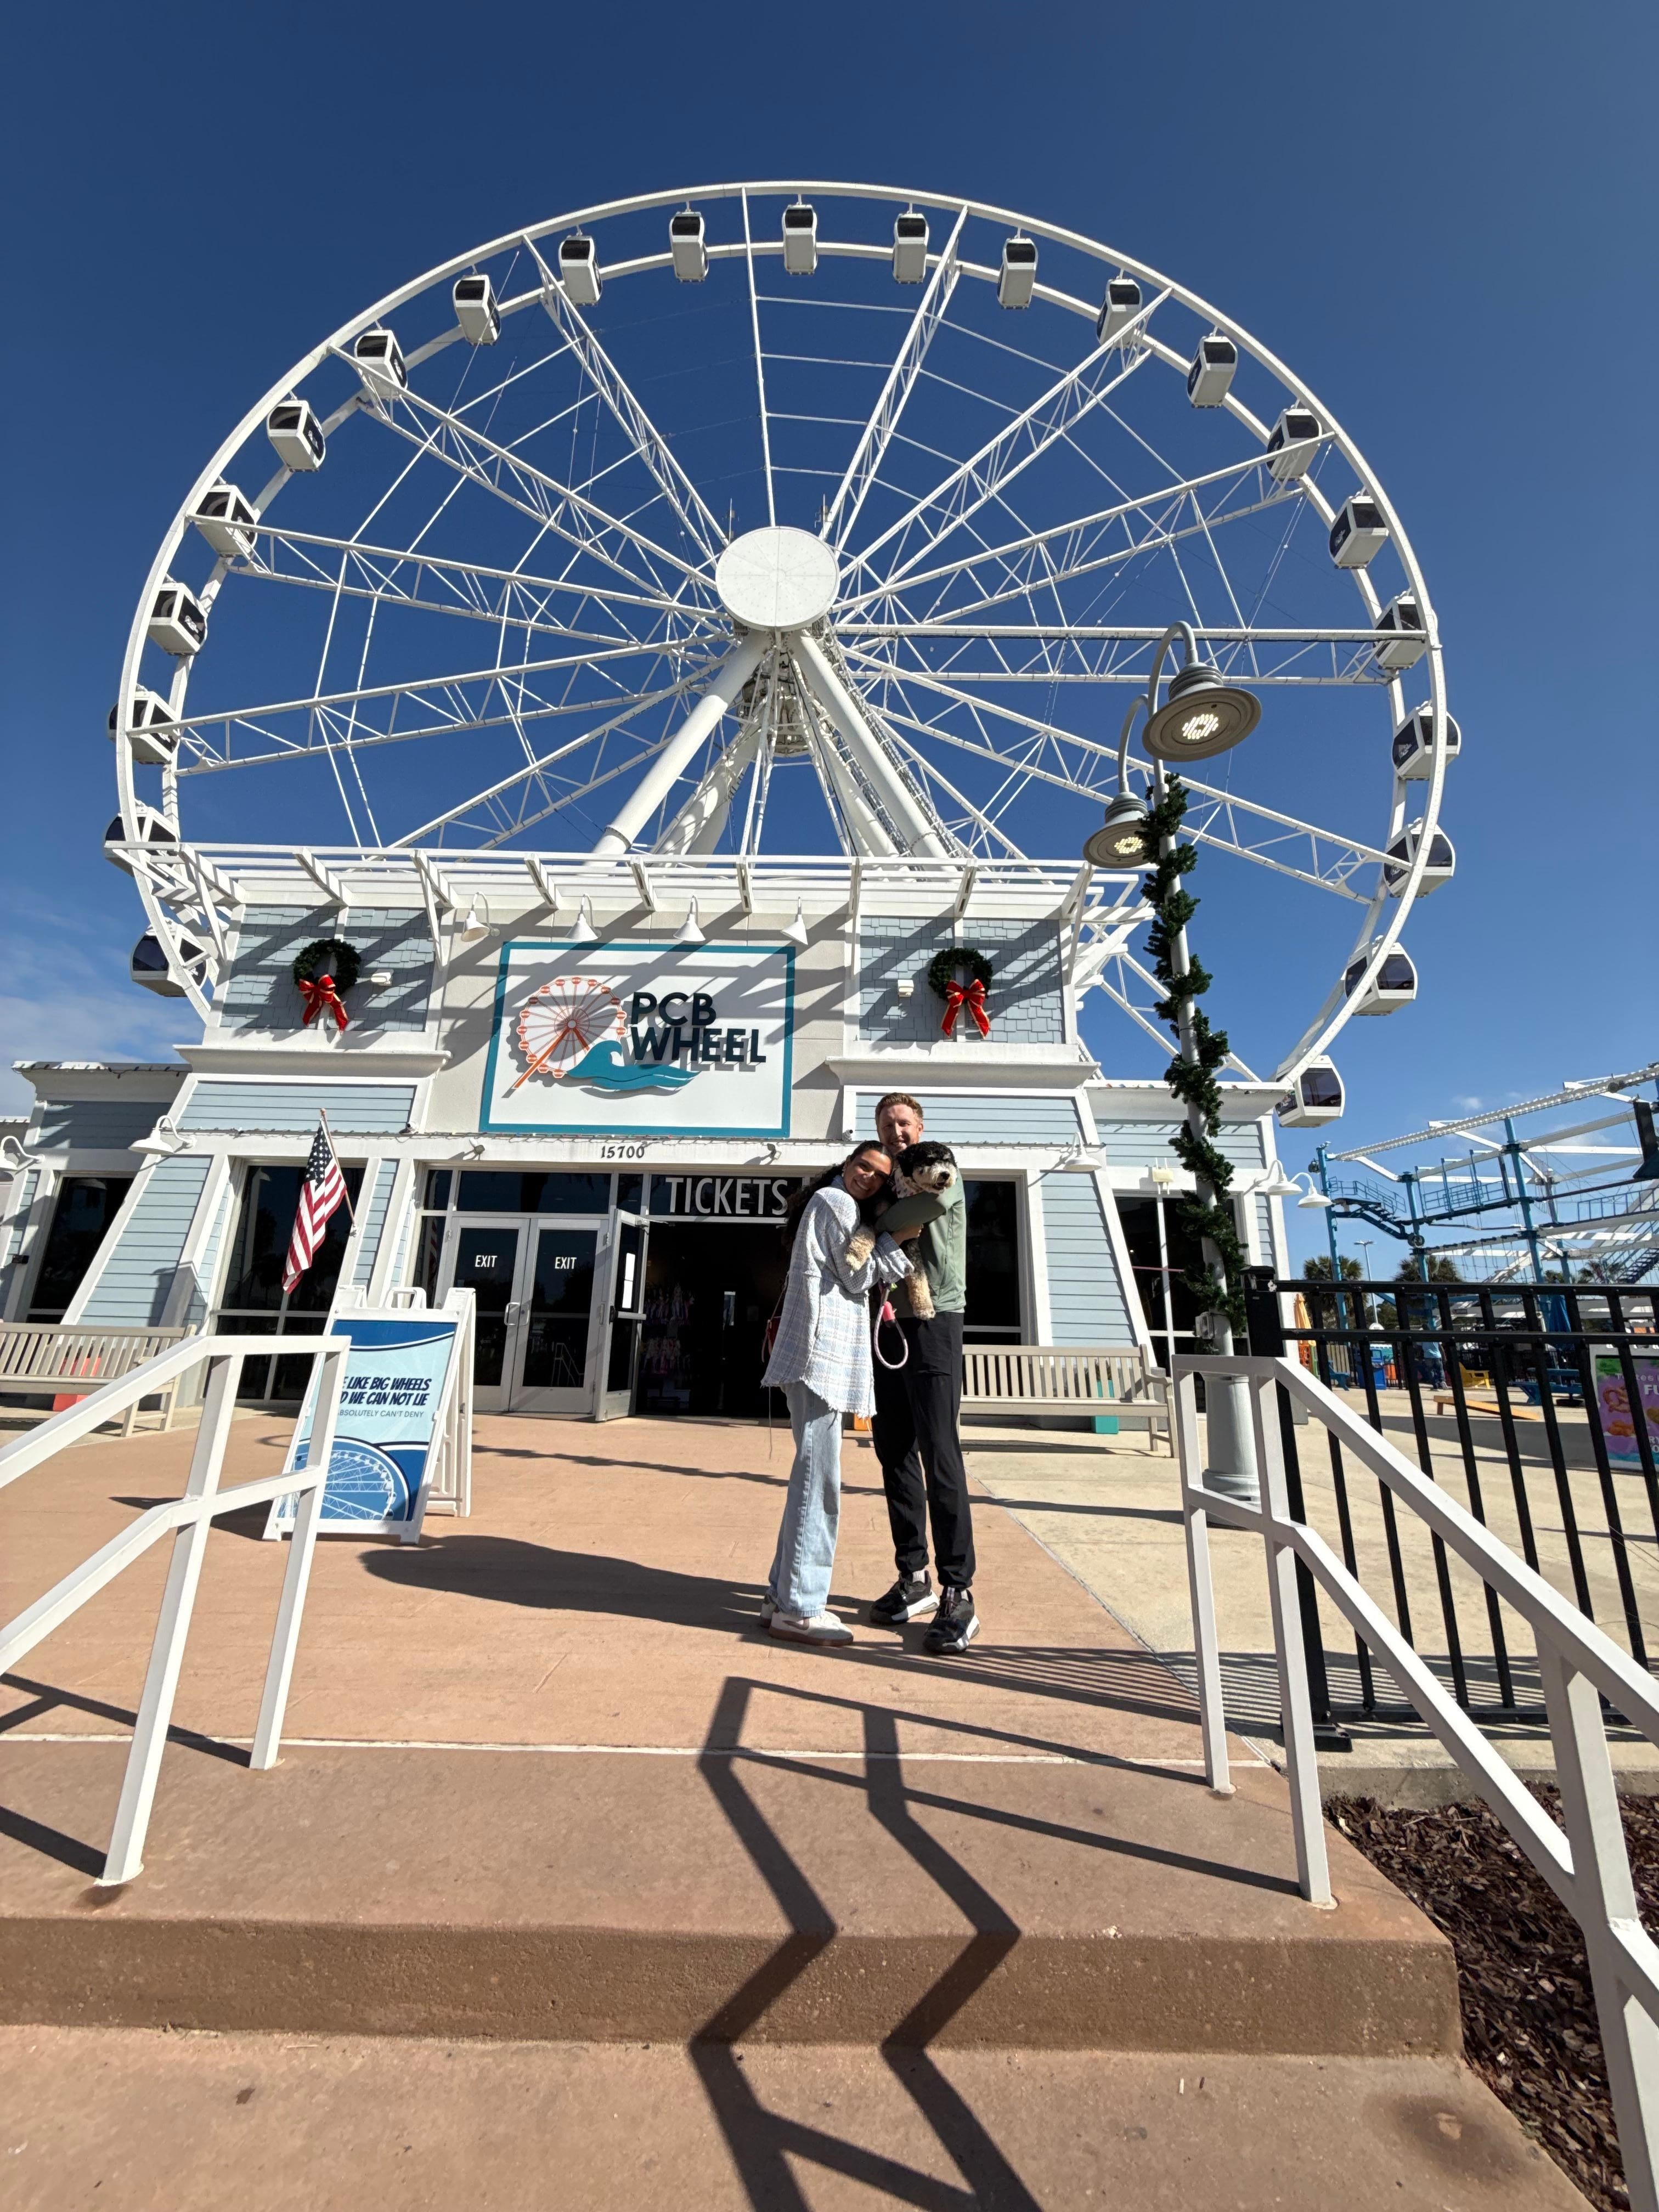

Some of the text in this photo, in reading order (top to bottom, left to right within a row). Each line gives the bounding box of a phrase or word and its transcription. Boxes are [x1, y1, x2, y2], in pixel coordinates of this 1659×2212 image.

[631, 991, 716, 1026] PCB
[630, 1027, 766, 1063] WHEEL
[601, 1145, 645, 1159] 15700
[665, 1177, 788, 1216] TICKETS
[475, 1255, 498, 1267] EXIT
[555, 1256, 577, 1269] EXIT
[347, 1376, 371, 1390] LIKE
[369, 1376, 391, 1391] BIG
[390, 1377, 432, 1391] WHEELS
[1615, 1373, 1654, 1381] Ttes
[348, 1391, 368, 1404] WE
[366, 1392, 391, 1405] CAN
[388, 1392, 414, 1406] NOT
[413, 1393, 430, 1406] LIE
[380, 1409, 403, 1418] CAN'T
